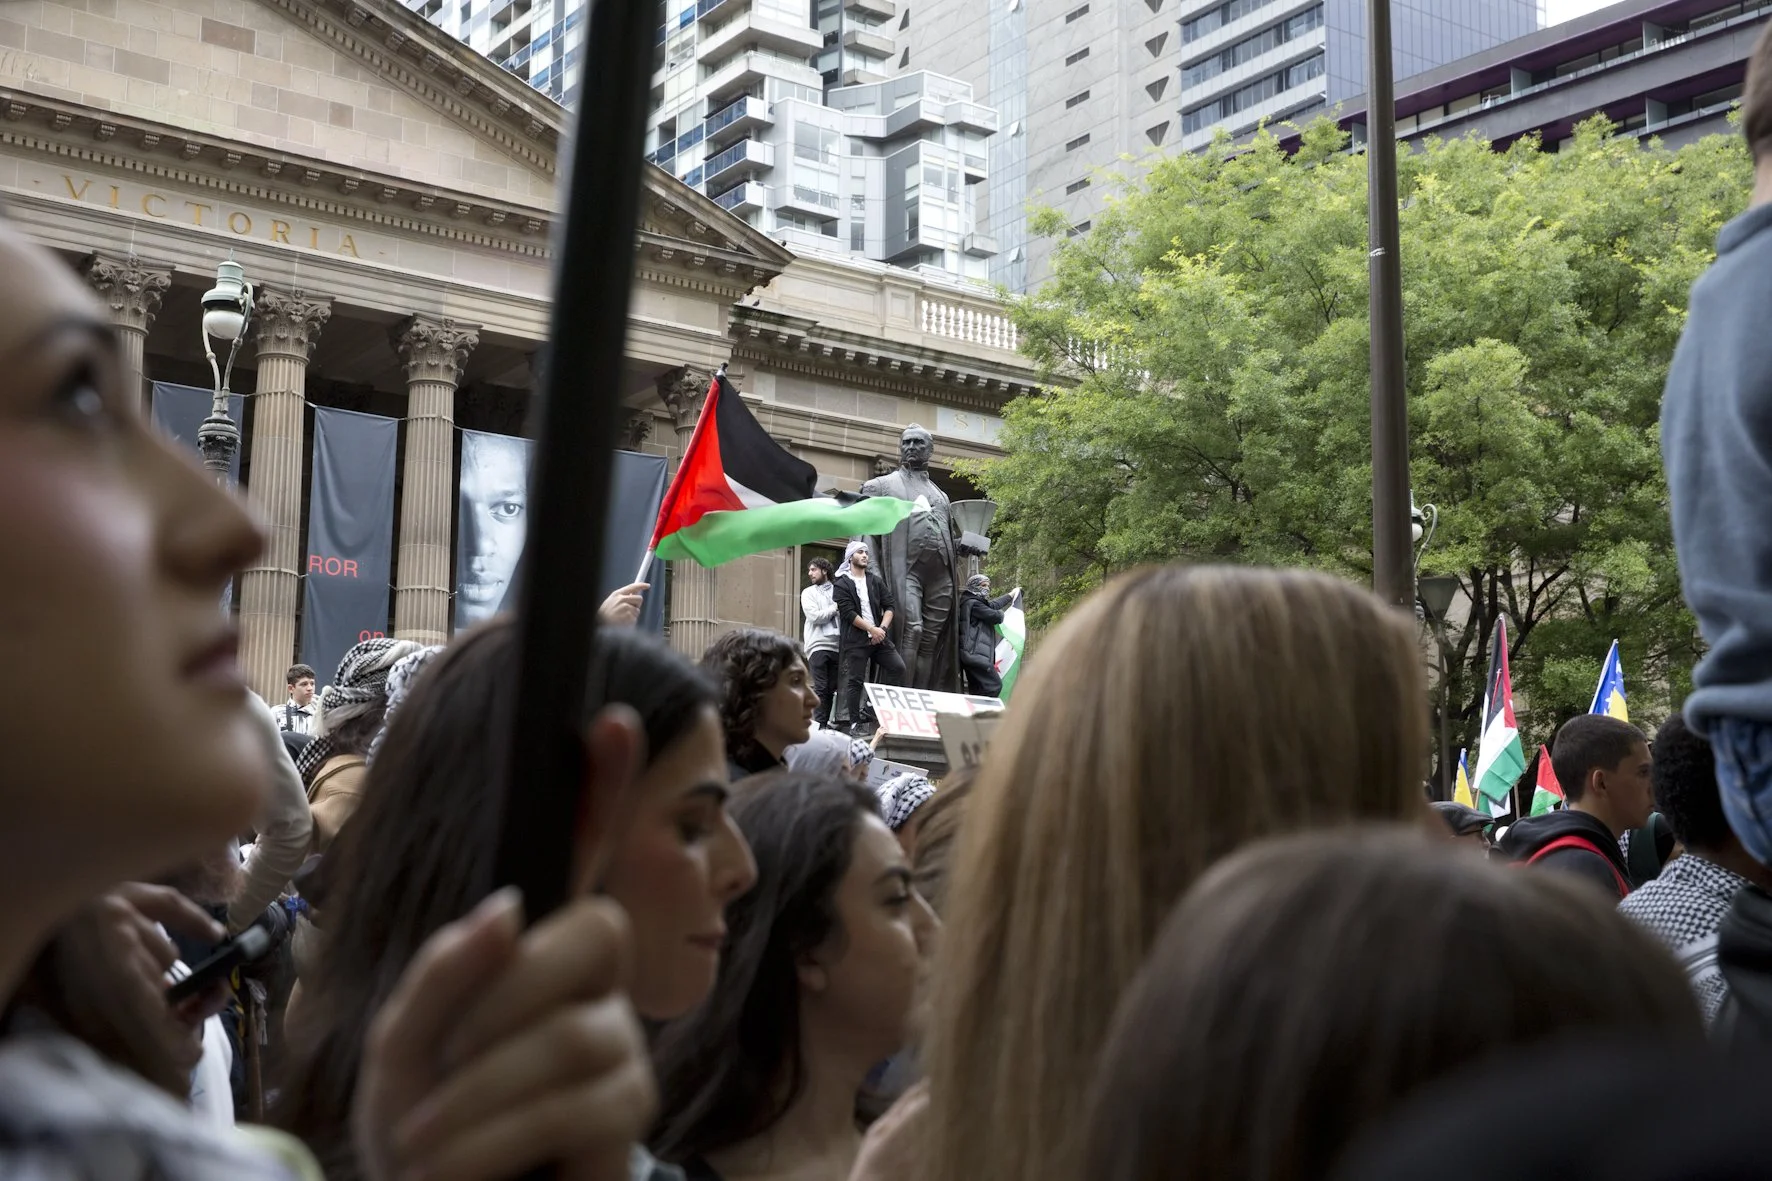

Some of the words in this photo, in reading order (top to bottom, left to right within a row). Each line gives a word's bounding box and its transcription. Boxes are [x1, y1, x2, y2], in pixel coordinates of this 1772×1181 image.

[61, 174, 361, 259] VICTORIA
[308, 554, 358, 578] ROR
[870, 686, 939, 712] FREE
